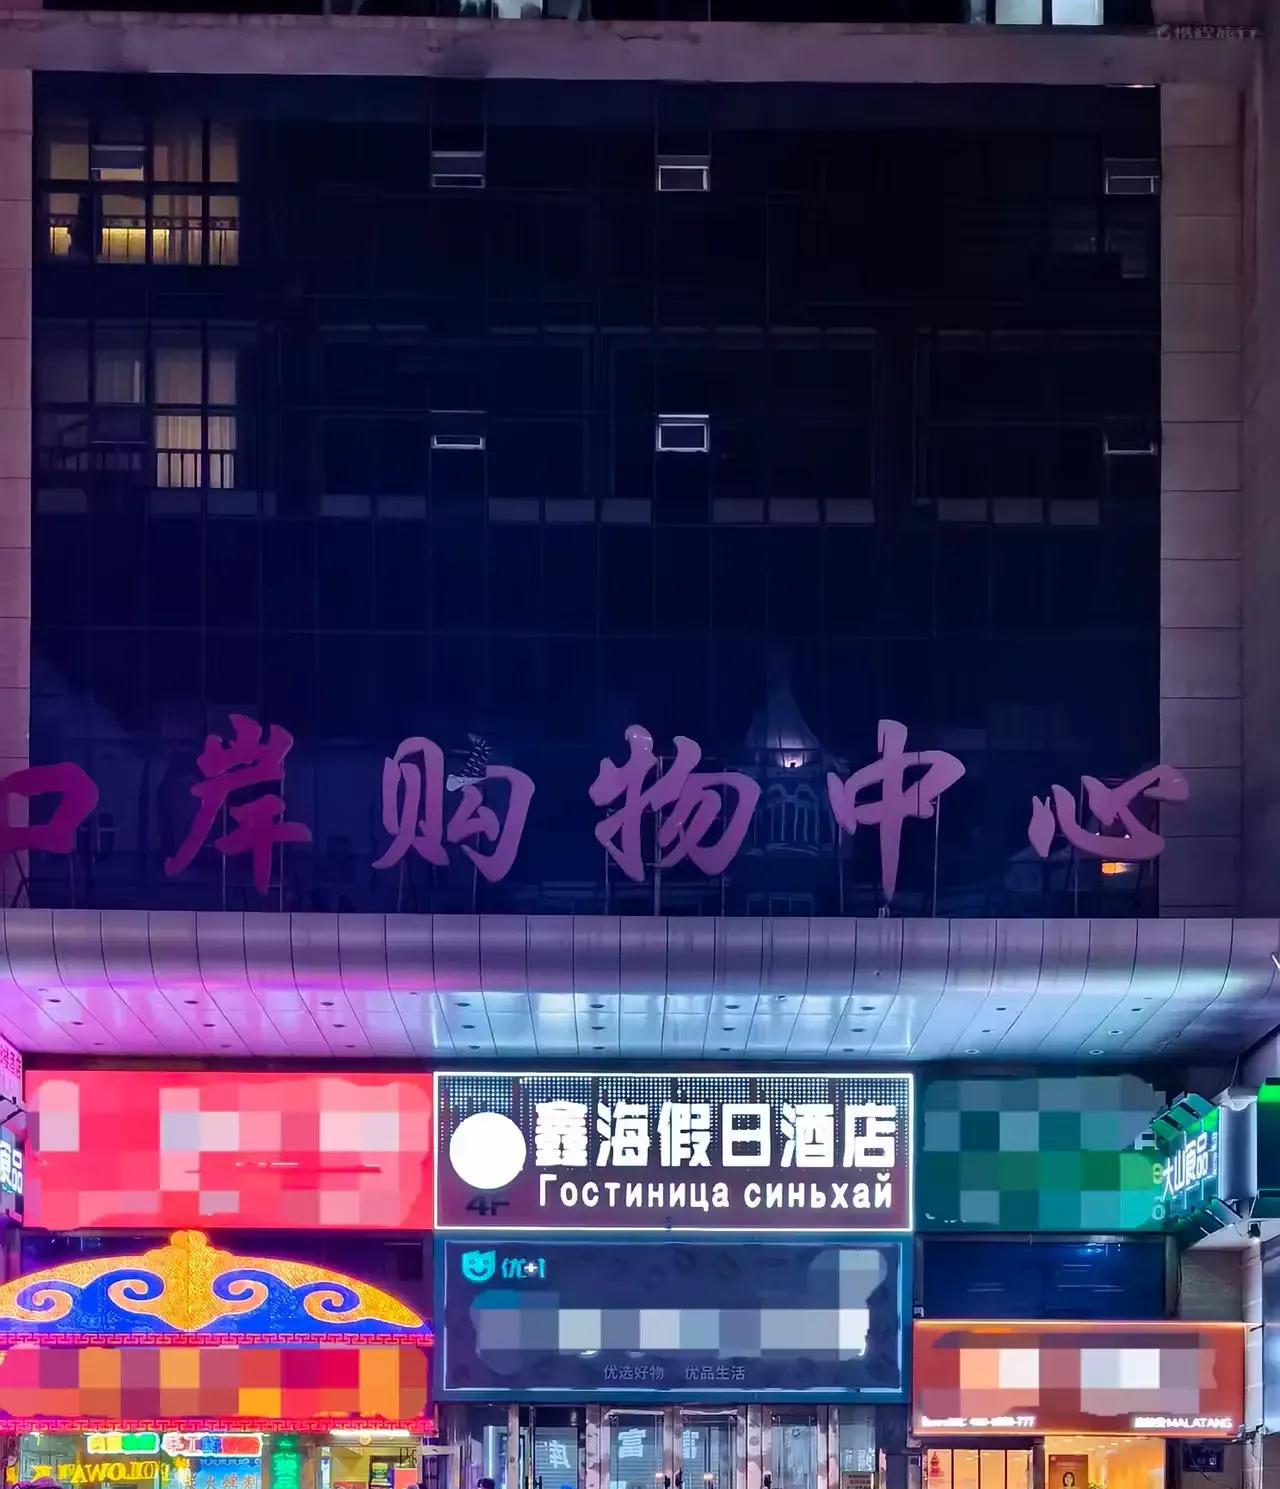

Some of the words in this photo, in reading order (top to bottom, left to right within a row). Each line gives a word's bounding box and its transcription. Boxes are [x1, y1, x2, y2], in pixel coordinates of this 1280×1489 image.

[0, 714, 1190, 903] 口岸购物中心
[534, 1101, 897, 1168] 鑫海假日酒店
[539, 1173, 730, 1212] Гостиница
[743, 1172, 893, 1209] синьхай
[603, 1364, 664, 1381] 优选好物
[684, 1364, 746, 1381] 优品生活
